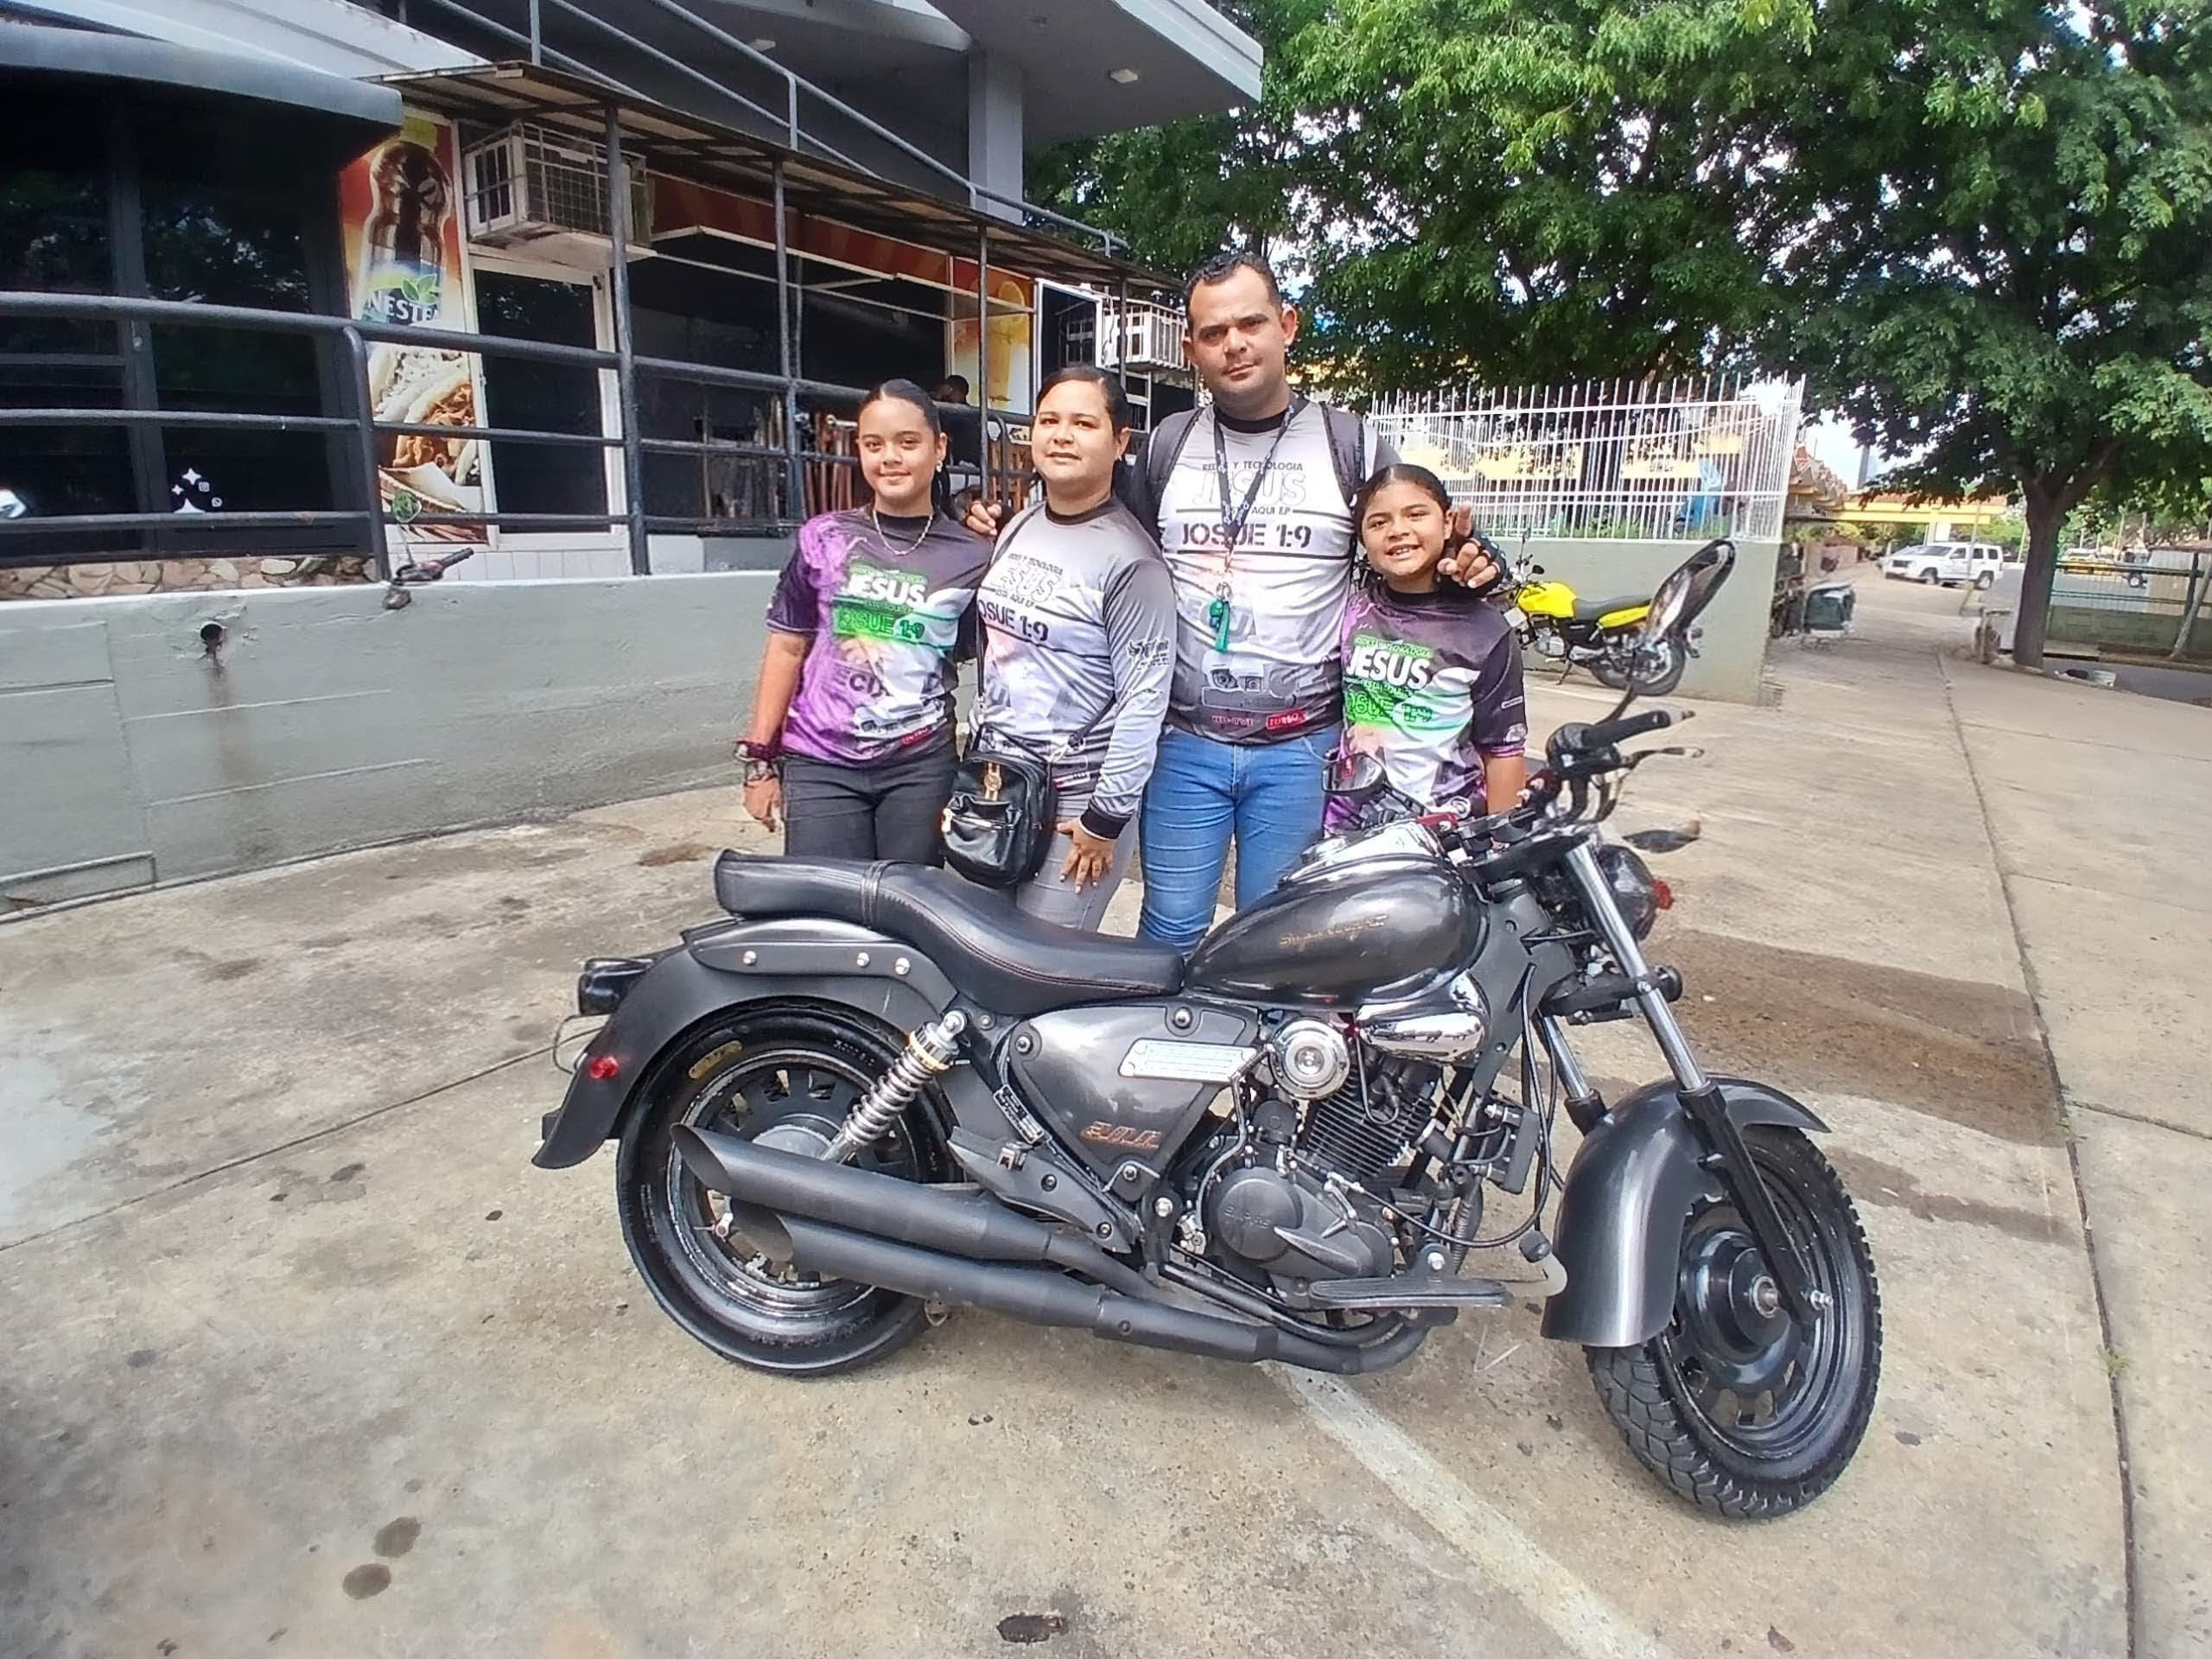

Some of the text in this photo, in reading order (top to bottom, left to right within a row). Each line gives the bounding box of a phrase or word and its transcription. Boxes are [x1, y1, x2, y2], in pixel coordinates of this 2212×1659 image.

[1192, 469, 1306, 506] JSUS
[1251, 505, 1275, 515] AQUI
[1275, 524, 1313, 549] 1:9
[899, 619, 926, 639] 1:9
[977, 600, 1049, 641] OSUE 1:9
[1345, 645, 1431, 690] JESUS
